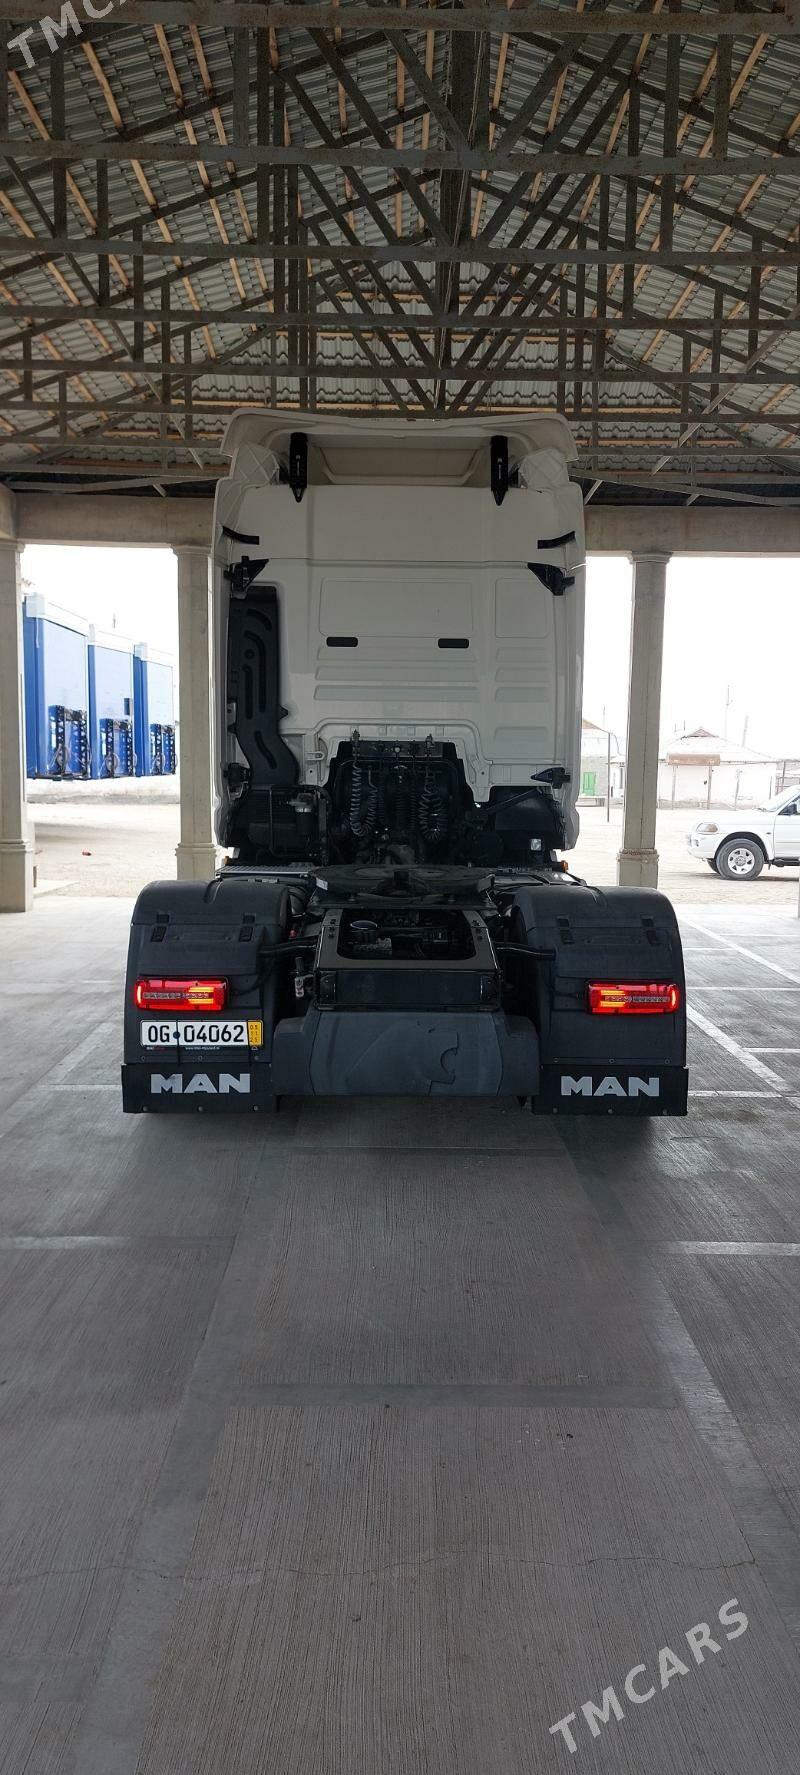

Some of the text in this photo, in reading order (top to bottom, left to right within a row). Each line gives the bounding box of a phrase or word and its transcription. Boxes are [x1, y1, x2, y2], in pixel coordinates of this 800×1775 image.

[148, 1025, 244, 1043] OG 04062
[150, 1073, 251, 1094] MAN
[560, 1076, 660, 1097] MAN
